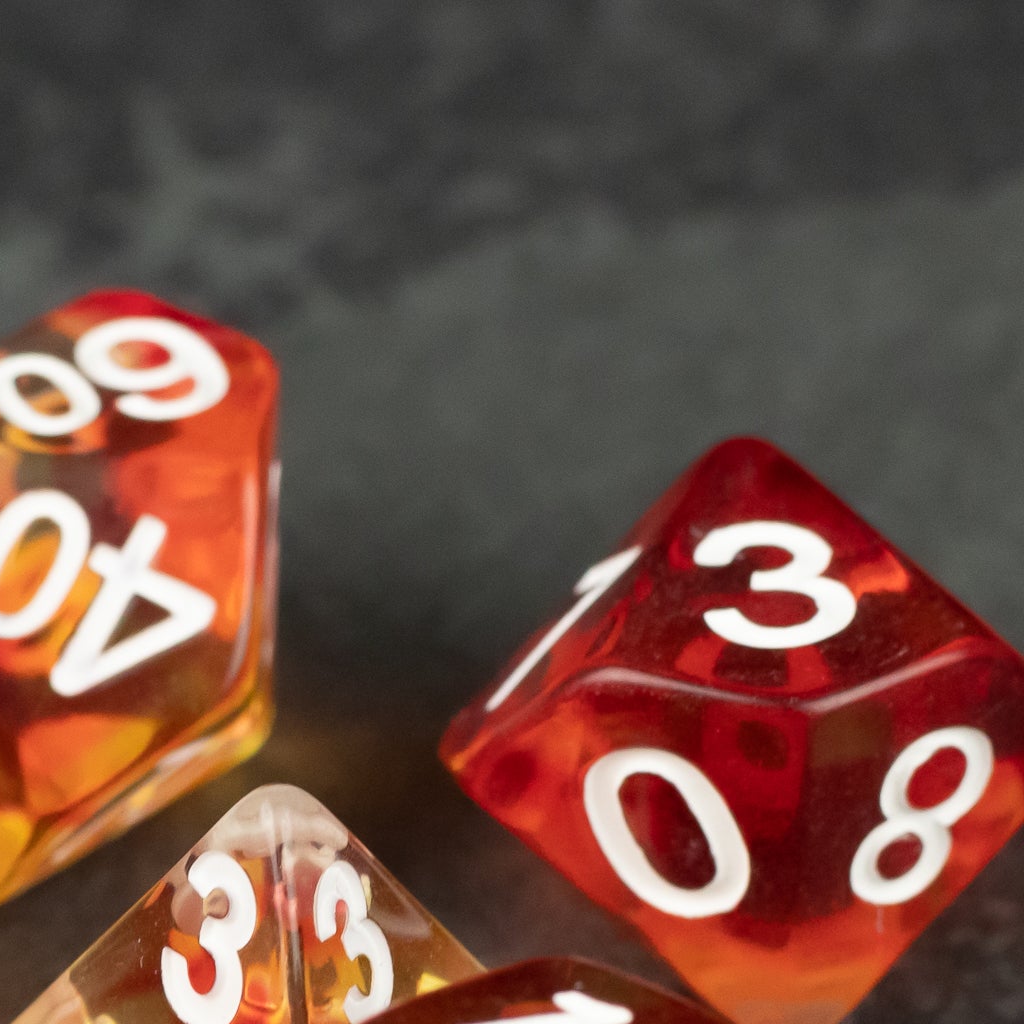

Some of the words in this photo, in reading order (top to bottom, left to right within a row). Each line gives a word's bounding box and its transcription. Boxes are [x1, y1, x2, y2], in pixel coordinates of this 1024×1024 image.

[693, 520, 857, 650] 3
[582, 747, 751, 919] 0
[849, 726, 994, 905] 8
